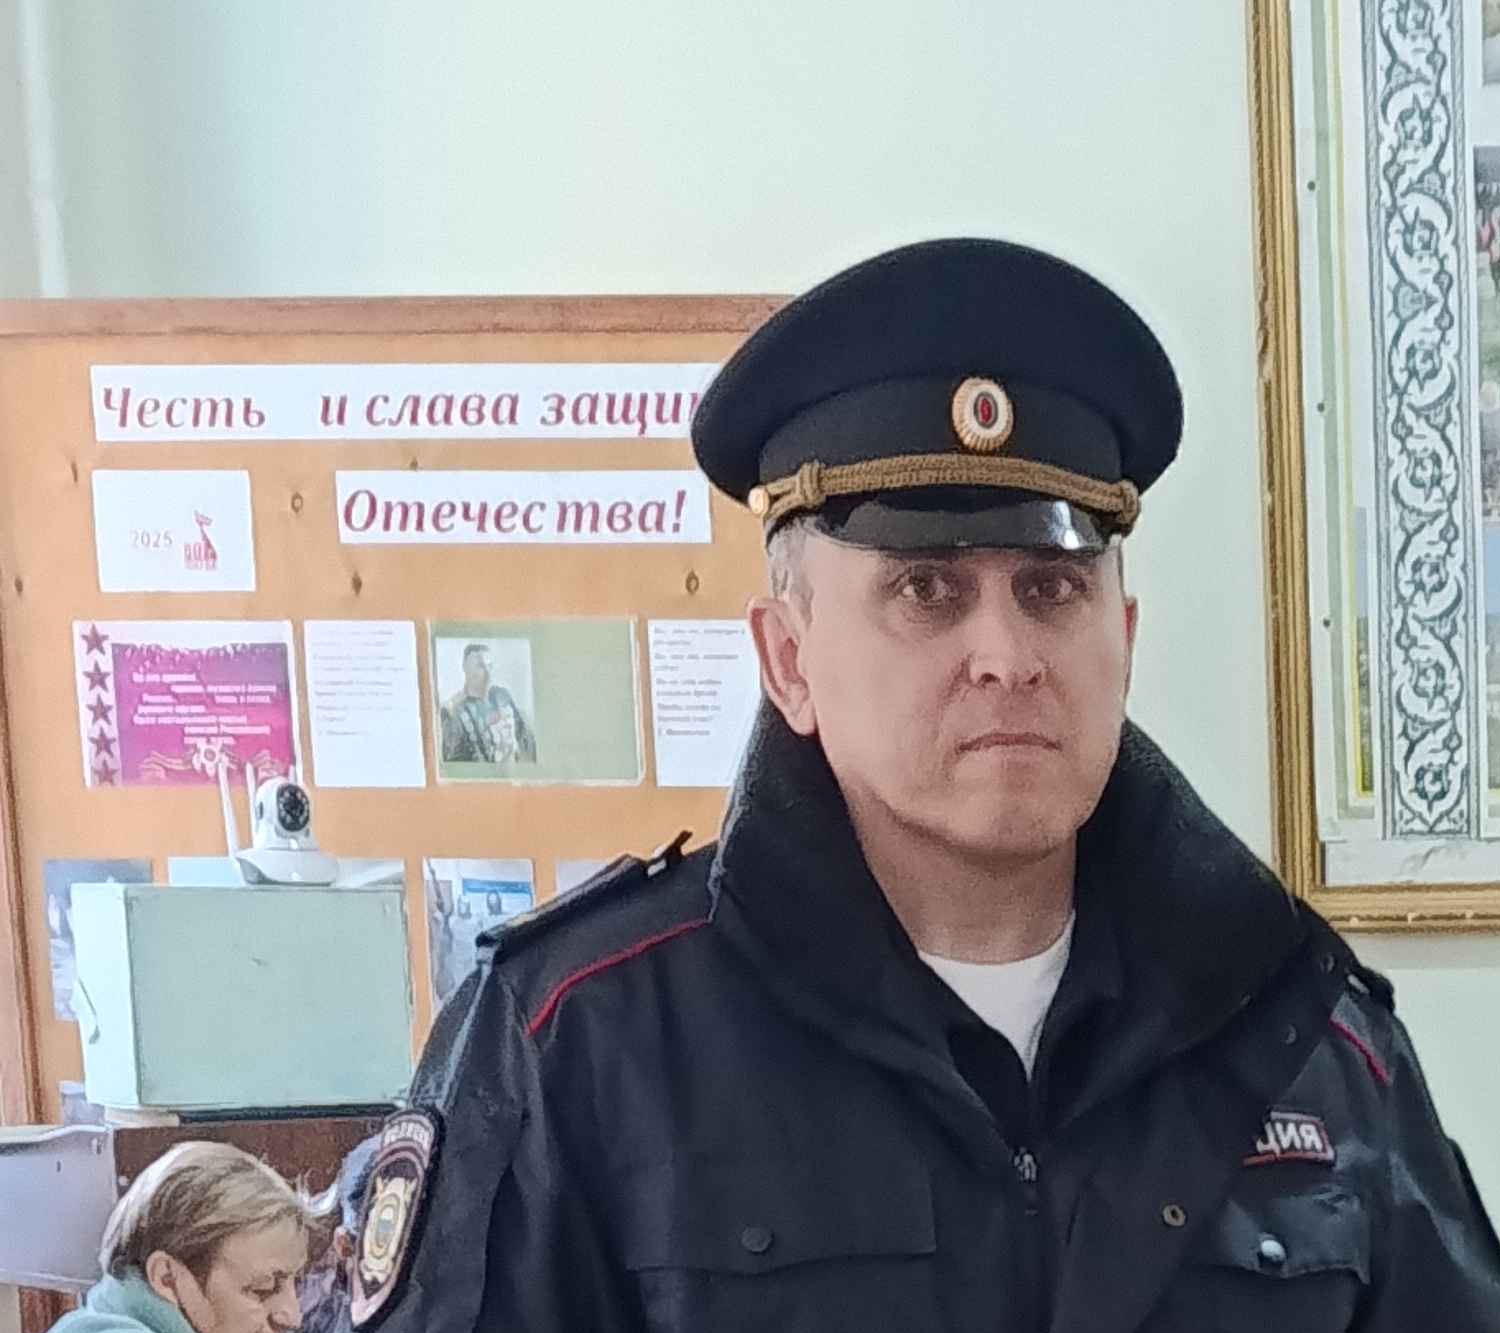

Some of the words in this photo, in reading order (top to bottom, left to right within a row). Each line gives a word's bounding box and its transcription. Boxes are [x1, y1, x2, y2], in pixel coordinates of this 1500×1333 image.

[102, 387, 266, 430] Честь
[320, 391, 348, 427] и
[365, 391, 520, 428] слава
[343, 490, 687, 535] Отечества!
[131, 529, 173, 548] 2025
